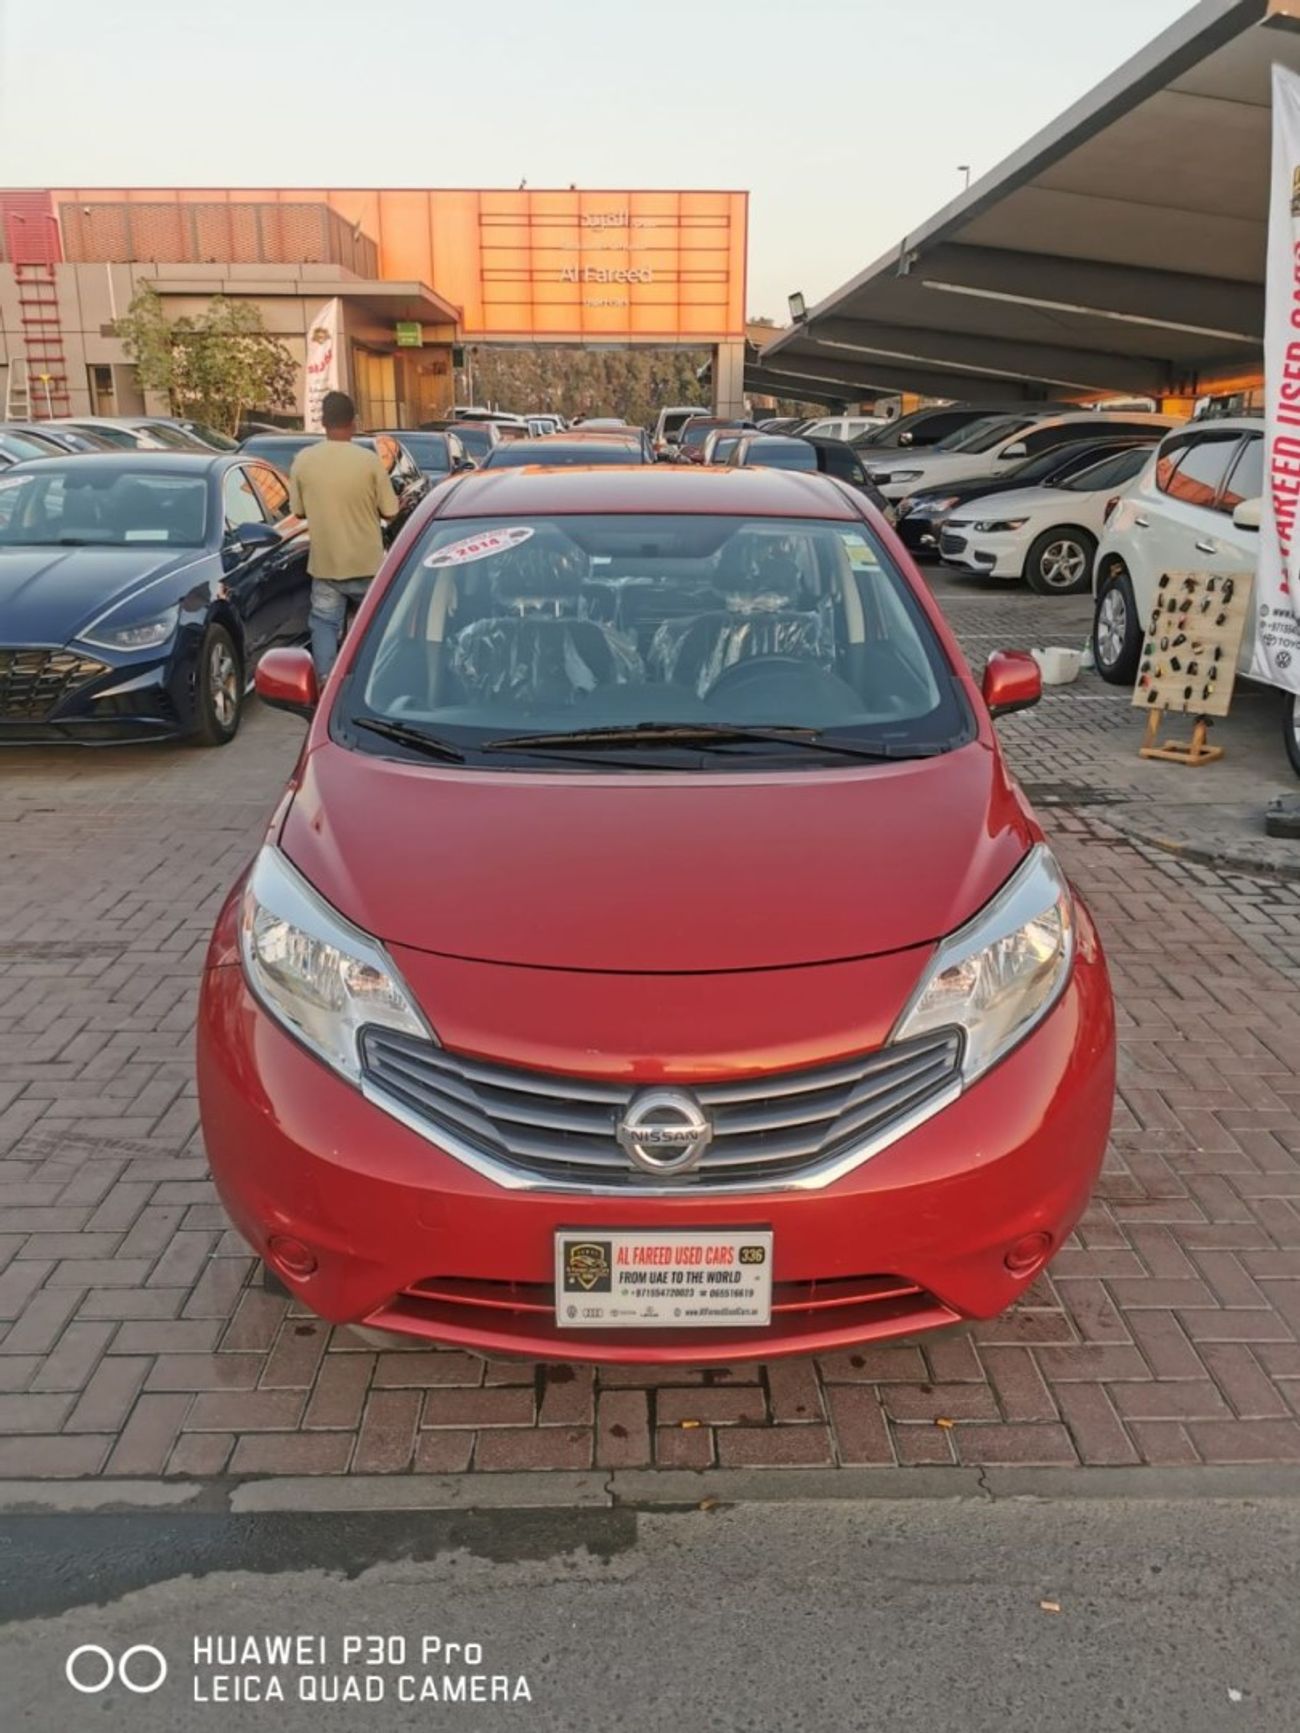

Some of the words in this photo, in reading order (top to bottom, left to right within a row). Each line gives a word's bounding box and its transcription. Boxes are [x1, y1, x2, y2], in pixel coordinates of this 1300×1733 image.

[561, 265, 578, 282] Al
[584, 265, 652, 283] Fareed
[631, 1130, 698, 1142] NISSAN
[617, 1247, 629, 1265] AL
[633, 1247, 672, 1265] FAREED
[675, 1246, 703, 1265] USED
[706, 1246, 734, 1264] CARS
[741, 1249, 763, 1262] 336
[619, 1271, 647, 1284] FROM
[649, 1271, 668, 1284] UAE
[671, 1271, 683, 1284] TO
[686, 1271, 704, 1284] THE
[707, 1271, 742, 1284] WORLD
